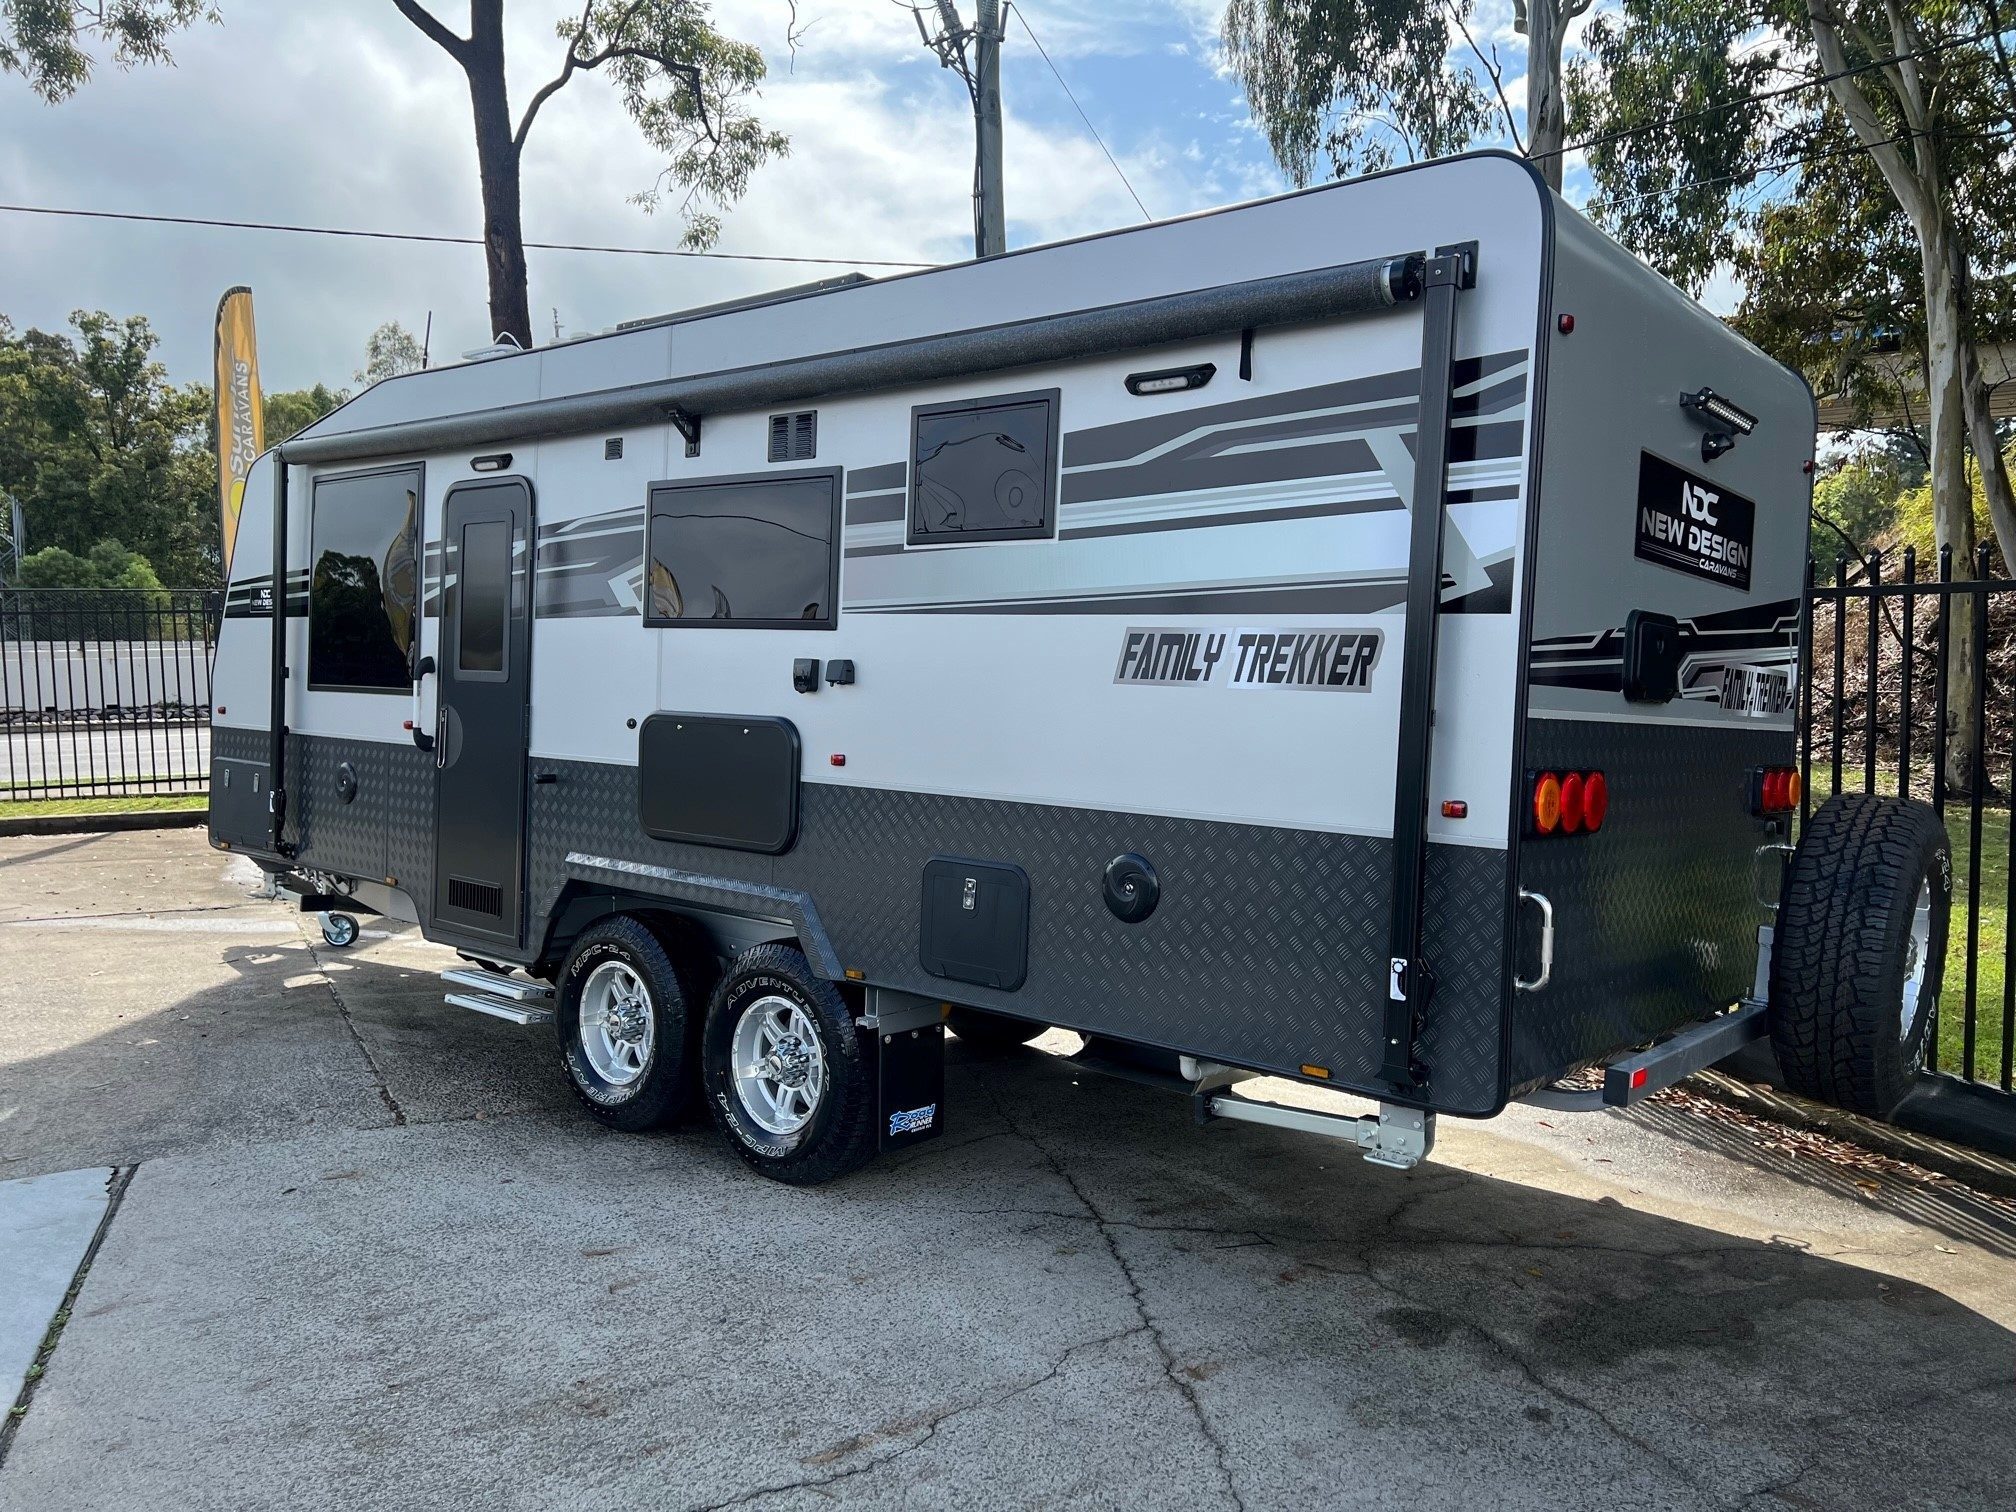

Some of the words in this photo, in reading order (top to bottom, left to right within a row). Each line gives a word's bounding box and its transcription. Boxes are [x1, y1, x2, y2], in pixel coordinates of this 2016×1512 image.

[235, 362, 256, 463] CARAVANS
[1681, 480, 1720, 526] NDC
[1641, 506, 1685, 546] NEW
[1688, 525, 1749, 569] DESIGN
[1699, 558, 1737, 579] CARAVANS
[1118, 633, 1226, 682] FAMILY
[1234, 633, 1379, 686] TREKKER
[1720, 667, 1755, 711] FAMILY
[1753, 672, 1788, 714] TREKKER
[571, 944, 631, 977] MPC-24
[728, 977, 822, 1033] ADVENTURE
[717, 1092, 787, 1157] MPC-24
